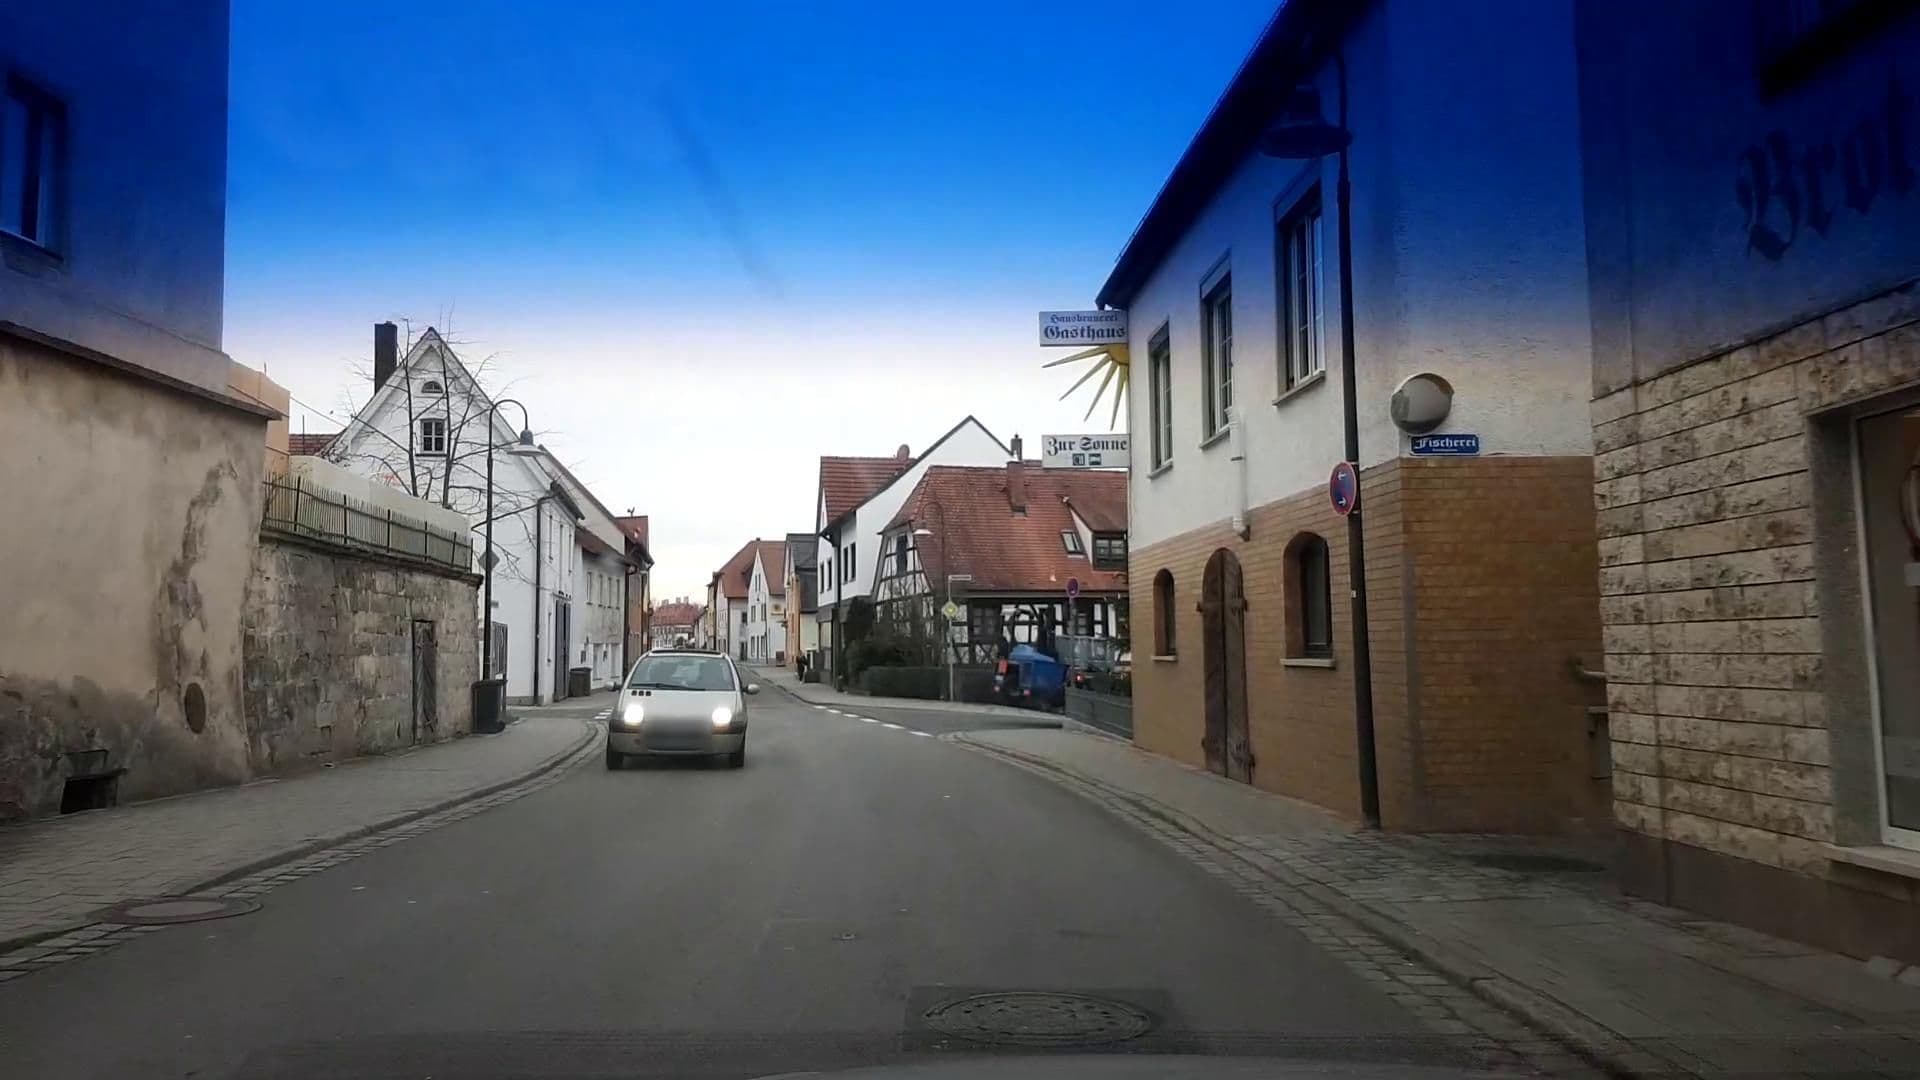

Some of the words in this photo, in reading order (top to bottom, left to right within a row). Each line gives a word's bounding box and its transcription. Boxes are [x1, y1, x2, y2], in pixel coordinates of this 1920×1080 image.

[1050, 313, 1118, 324] Hausbrauerei
[1044, 325, 1125, 341] Gasthaus
[1046, 436, 1076, 456] Zur
[1079, 436, 1127, 451] Sonne
[1414, 437, 1476, 449] Fischerei
